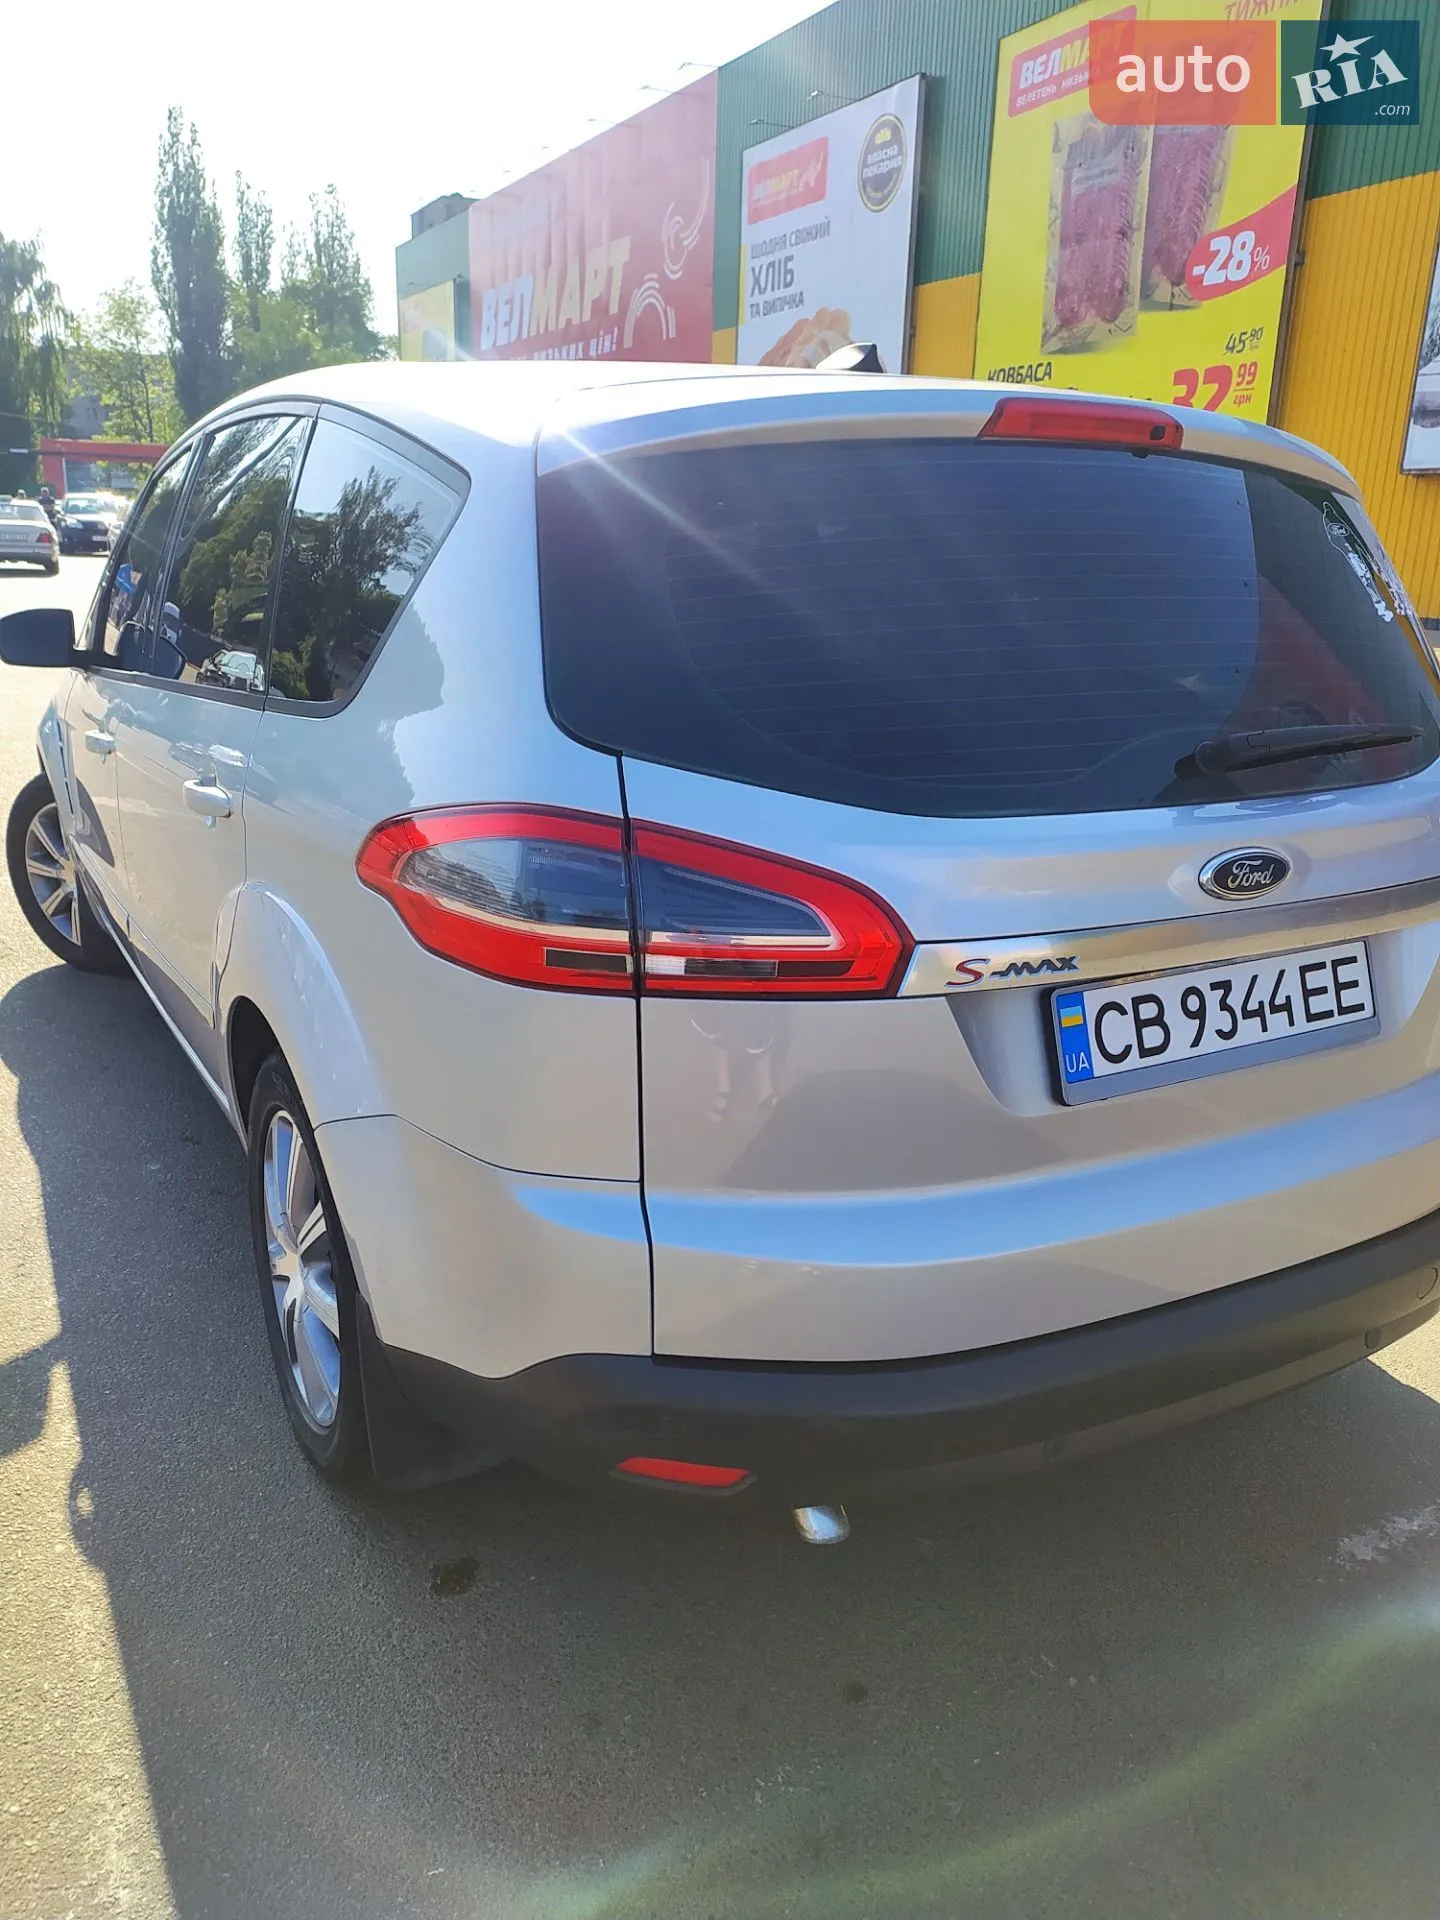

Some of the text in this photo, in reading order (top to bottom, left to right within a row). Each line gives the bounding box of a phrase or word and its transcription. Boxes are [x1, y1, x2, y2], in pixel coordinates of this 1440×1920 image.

[751, 232, 787, 260] ЩОДНЯ
[1192, 230, 1270, 287] -28%
[750, 254, 796, 298] ХЛІБ
[480, 235, 632, 350] ВЕЛМАРТ
[750, 290, 804, 319] ТА ВИПІЧКА
[987, 361, 1052, 384] КОВБАСА
[1227, 859, 1275, 889] Ford
[944, 954, 1081, 988] S-MAX
[1065, 1053, 1091, 1074] UA
